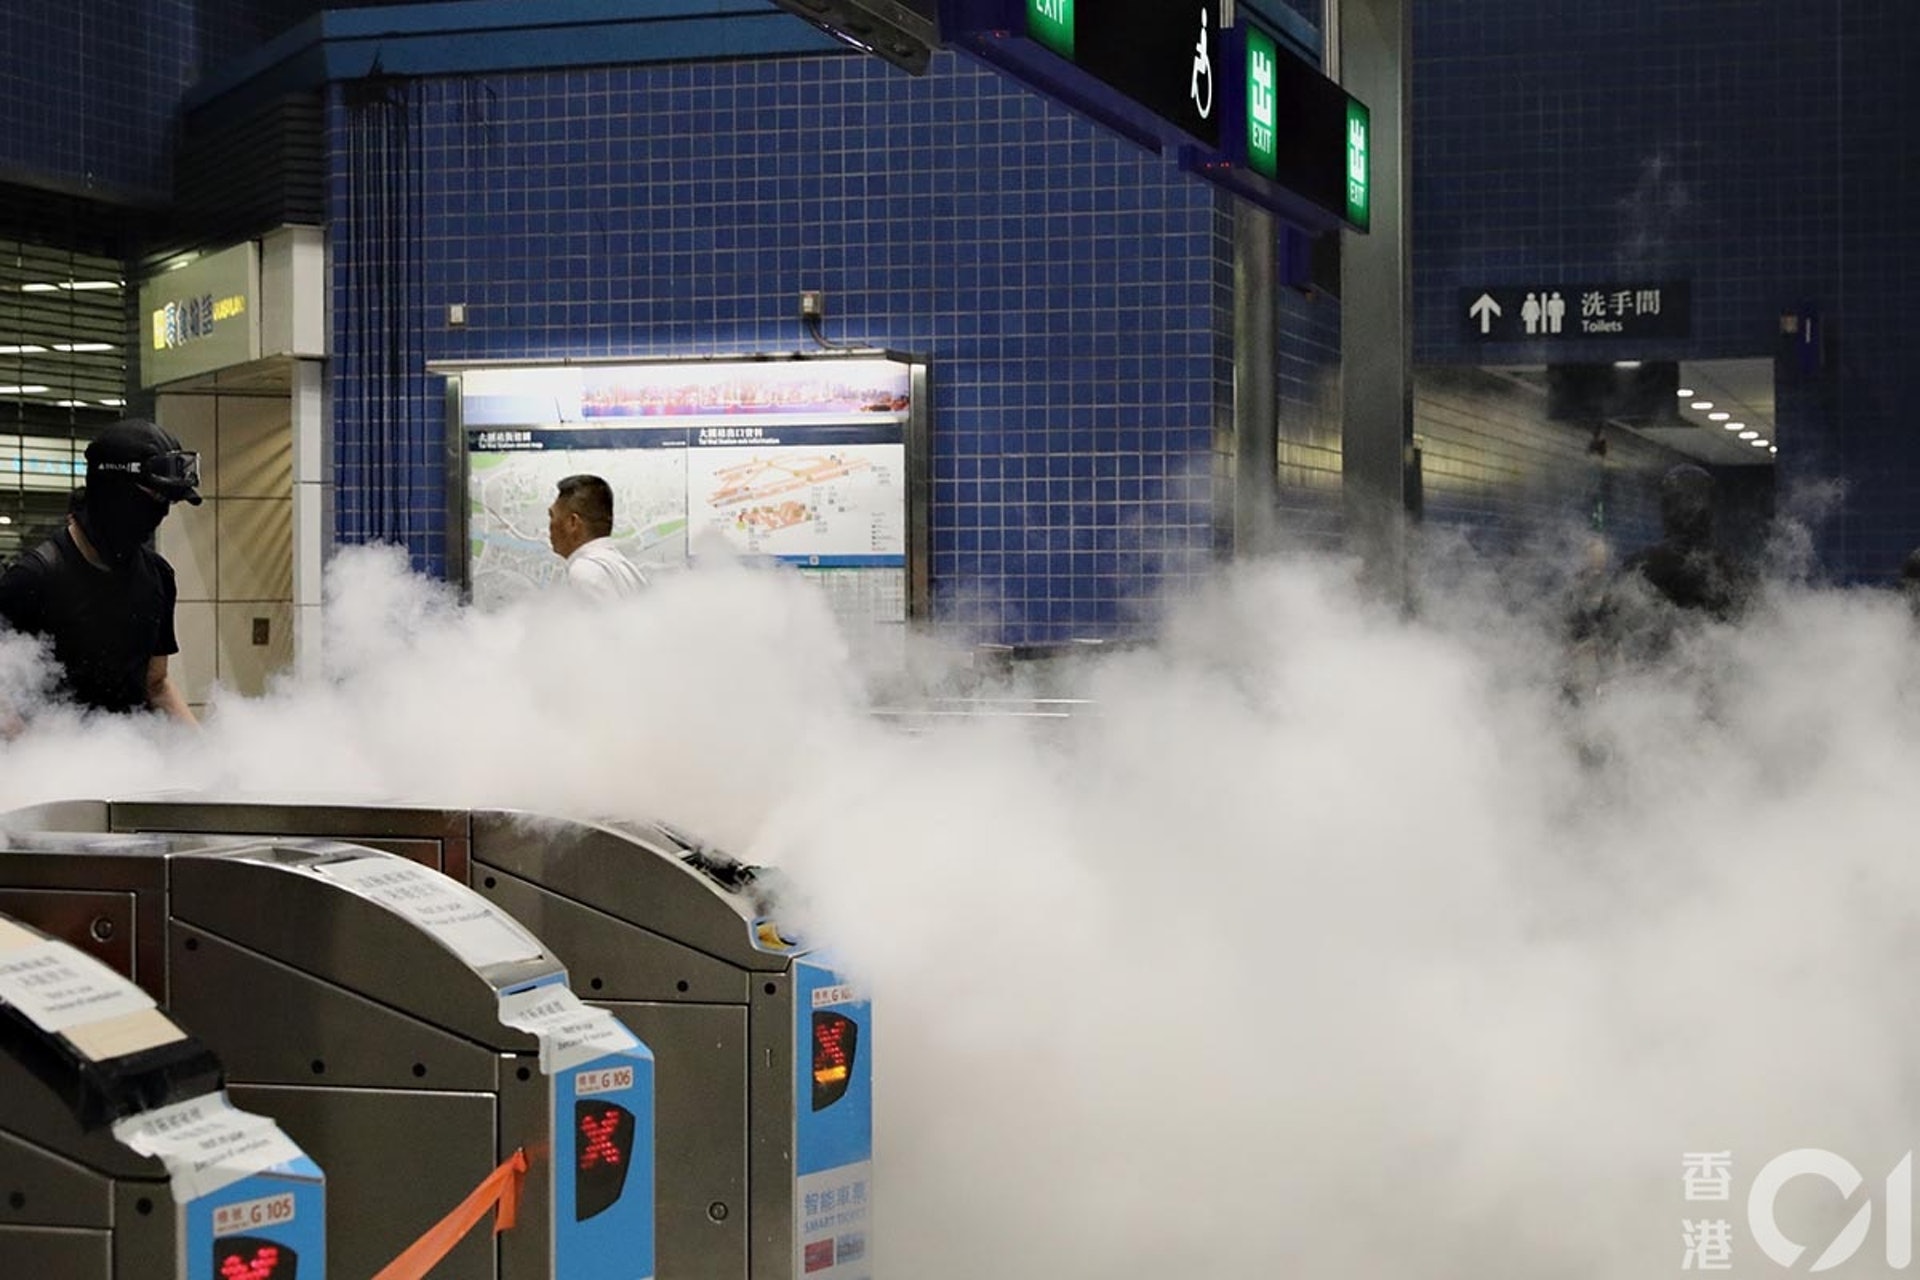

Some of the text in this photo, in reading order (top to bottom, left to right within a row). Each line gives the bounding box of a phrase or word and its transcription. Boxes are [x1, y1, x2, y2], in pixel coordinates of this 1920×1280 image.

[1252, 122, 1272, 155] EXIT
[1350, 179, 1364, 208] EXIT
[1581, 289, 1661, 317] 洗手間
[1582, 319, 1623, 332] Toilets
[831, 988, 840, 1002] G
[601, 1068, 632, 1089] G 106
[250, 1198, 292, 1224] G 105
